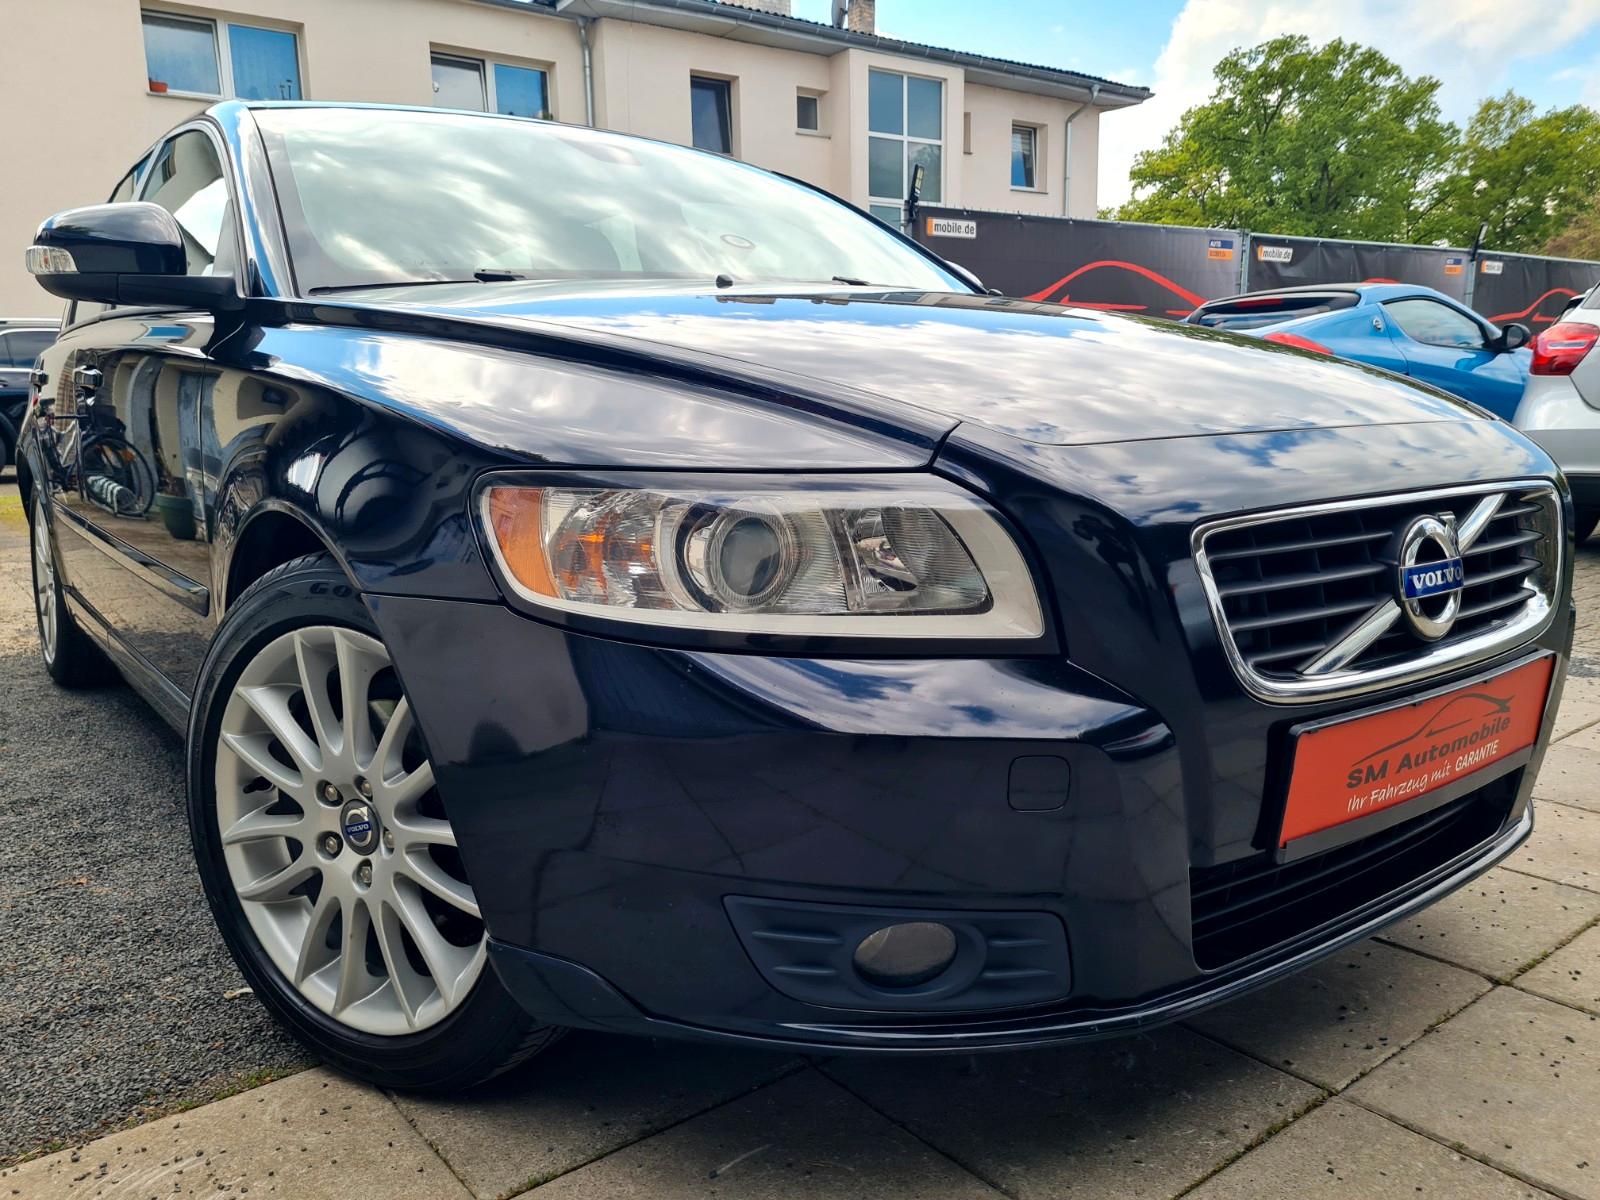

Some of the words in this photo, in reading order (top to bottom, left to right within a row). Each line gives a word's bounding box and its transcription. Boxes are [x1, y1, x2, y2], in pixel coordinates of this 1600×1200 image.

[934, 221, 975, 235] mobile.de
[1263, 247, 1291, 260] mobile.de
[1409, 566, 1462, 589] VOLVO
[1347, 760, 1389, 789] SM
[1395, 717, 1510, 774] Automobile
[1347, 795, 1367, 813] Ihr
[1370, 774, 1428, 806] Fahrzeug
[1431, 760, 1452, 782] mit
[1455, 740, 1499, 772] GARANTIE
